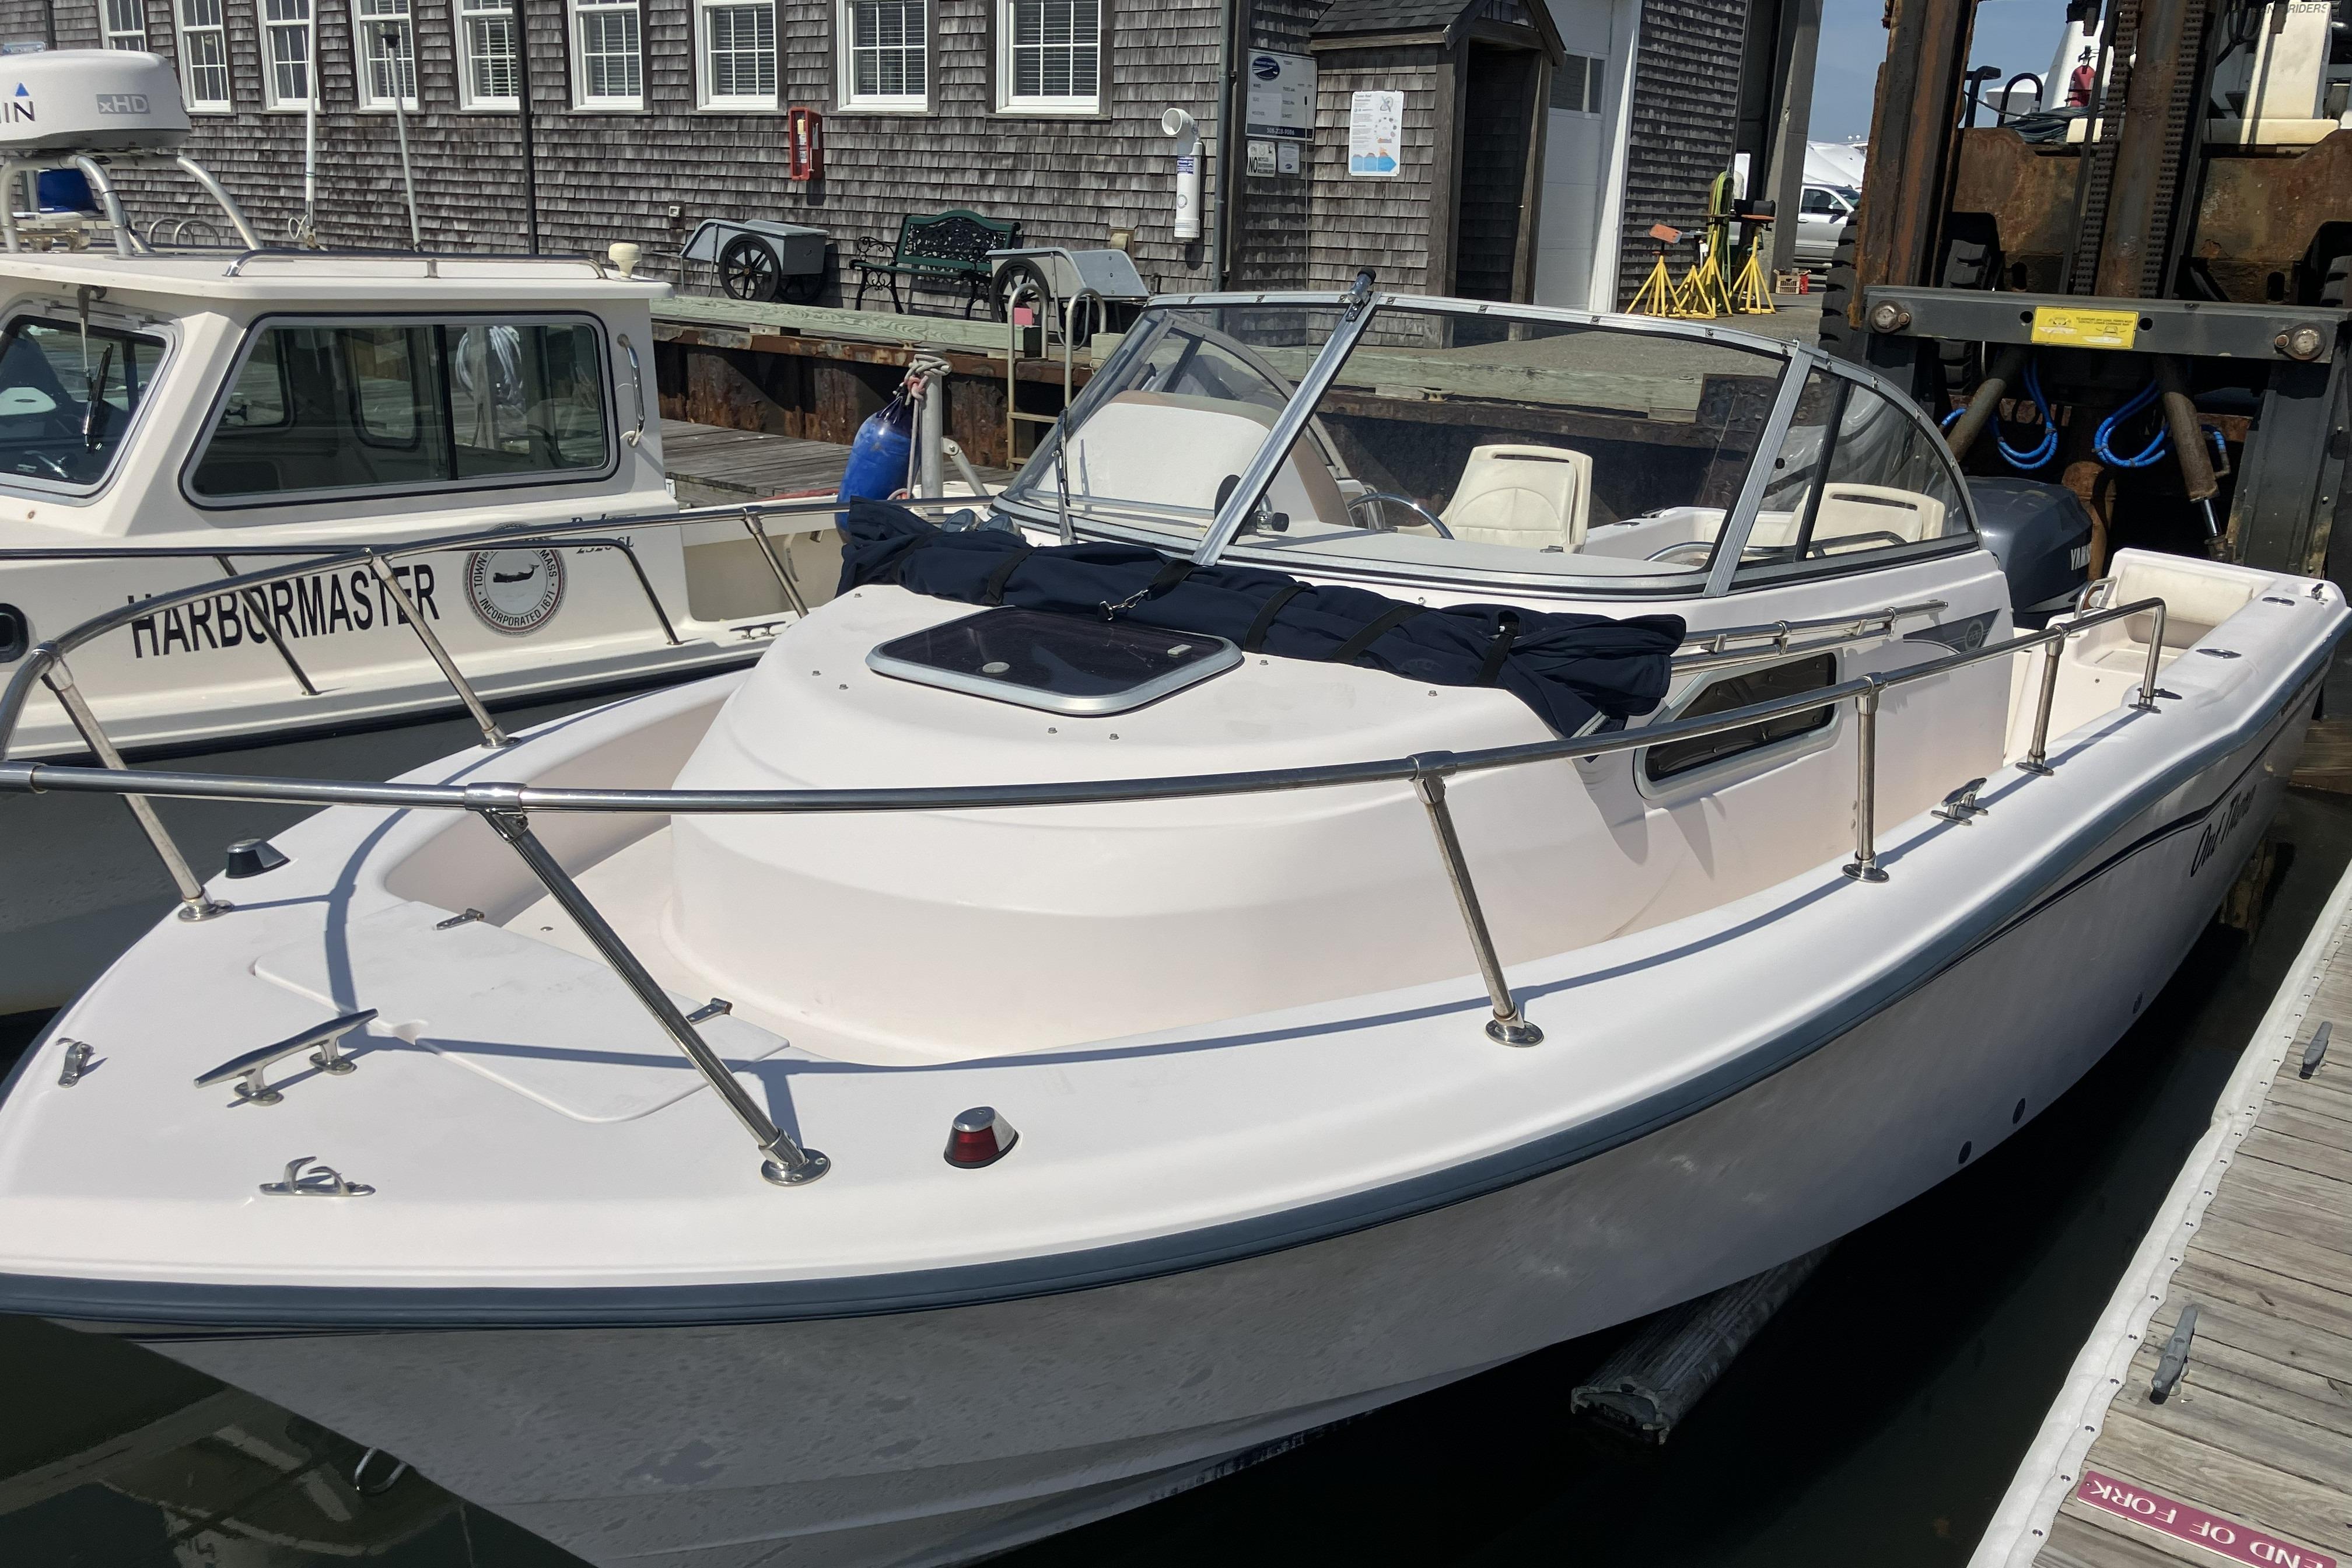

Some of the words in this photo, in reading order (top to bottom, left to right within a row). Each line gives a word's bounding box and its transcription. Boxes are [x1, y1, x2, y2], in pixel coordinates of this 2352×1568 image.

[2289, 4, 2328, 13] RIDERS
[0, 101, 36, 123] IN
[99, 95, 146, 113] xHD
[1248, 156, 1258, 173] NO
[474, 558, 487, 588] TOWN
[128, 564, 440, 658] HARBORMASTER
[480, 598, 541, 626] INCORPORATED
[541, 591, 555, 610] 1671
[2089, 1479, 2178, 1525] FORK
[2189, 1521, 2236, 1545] OF
